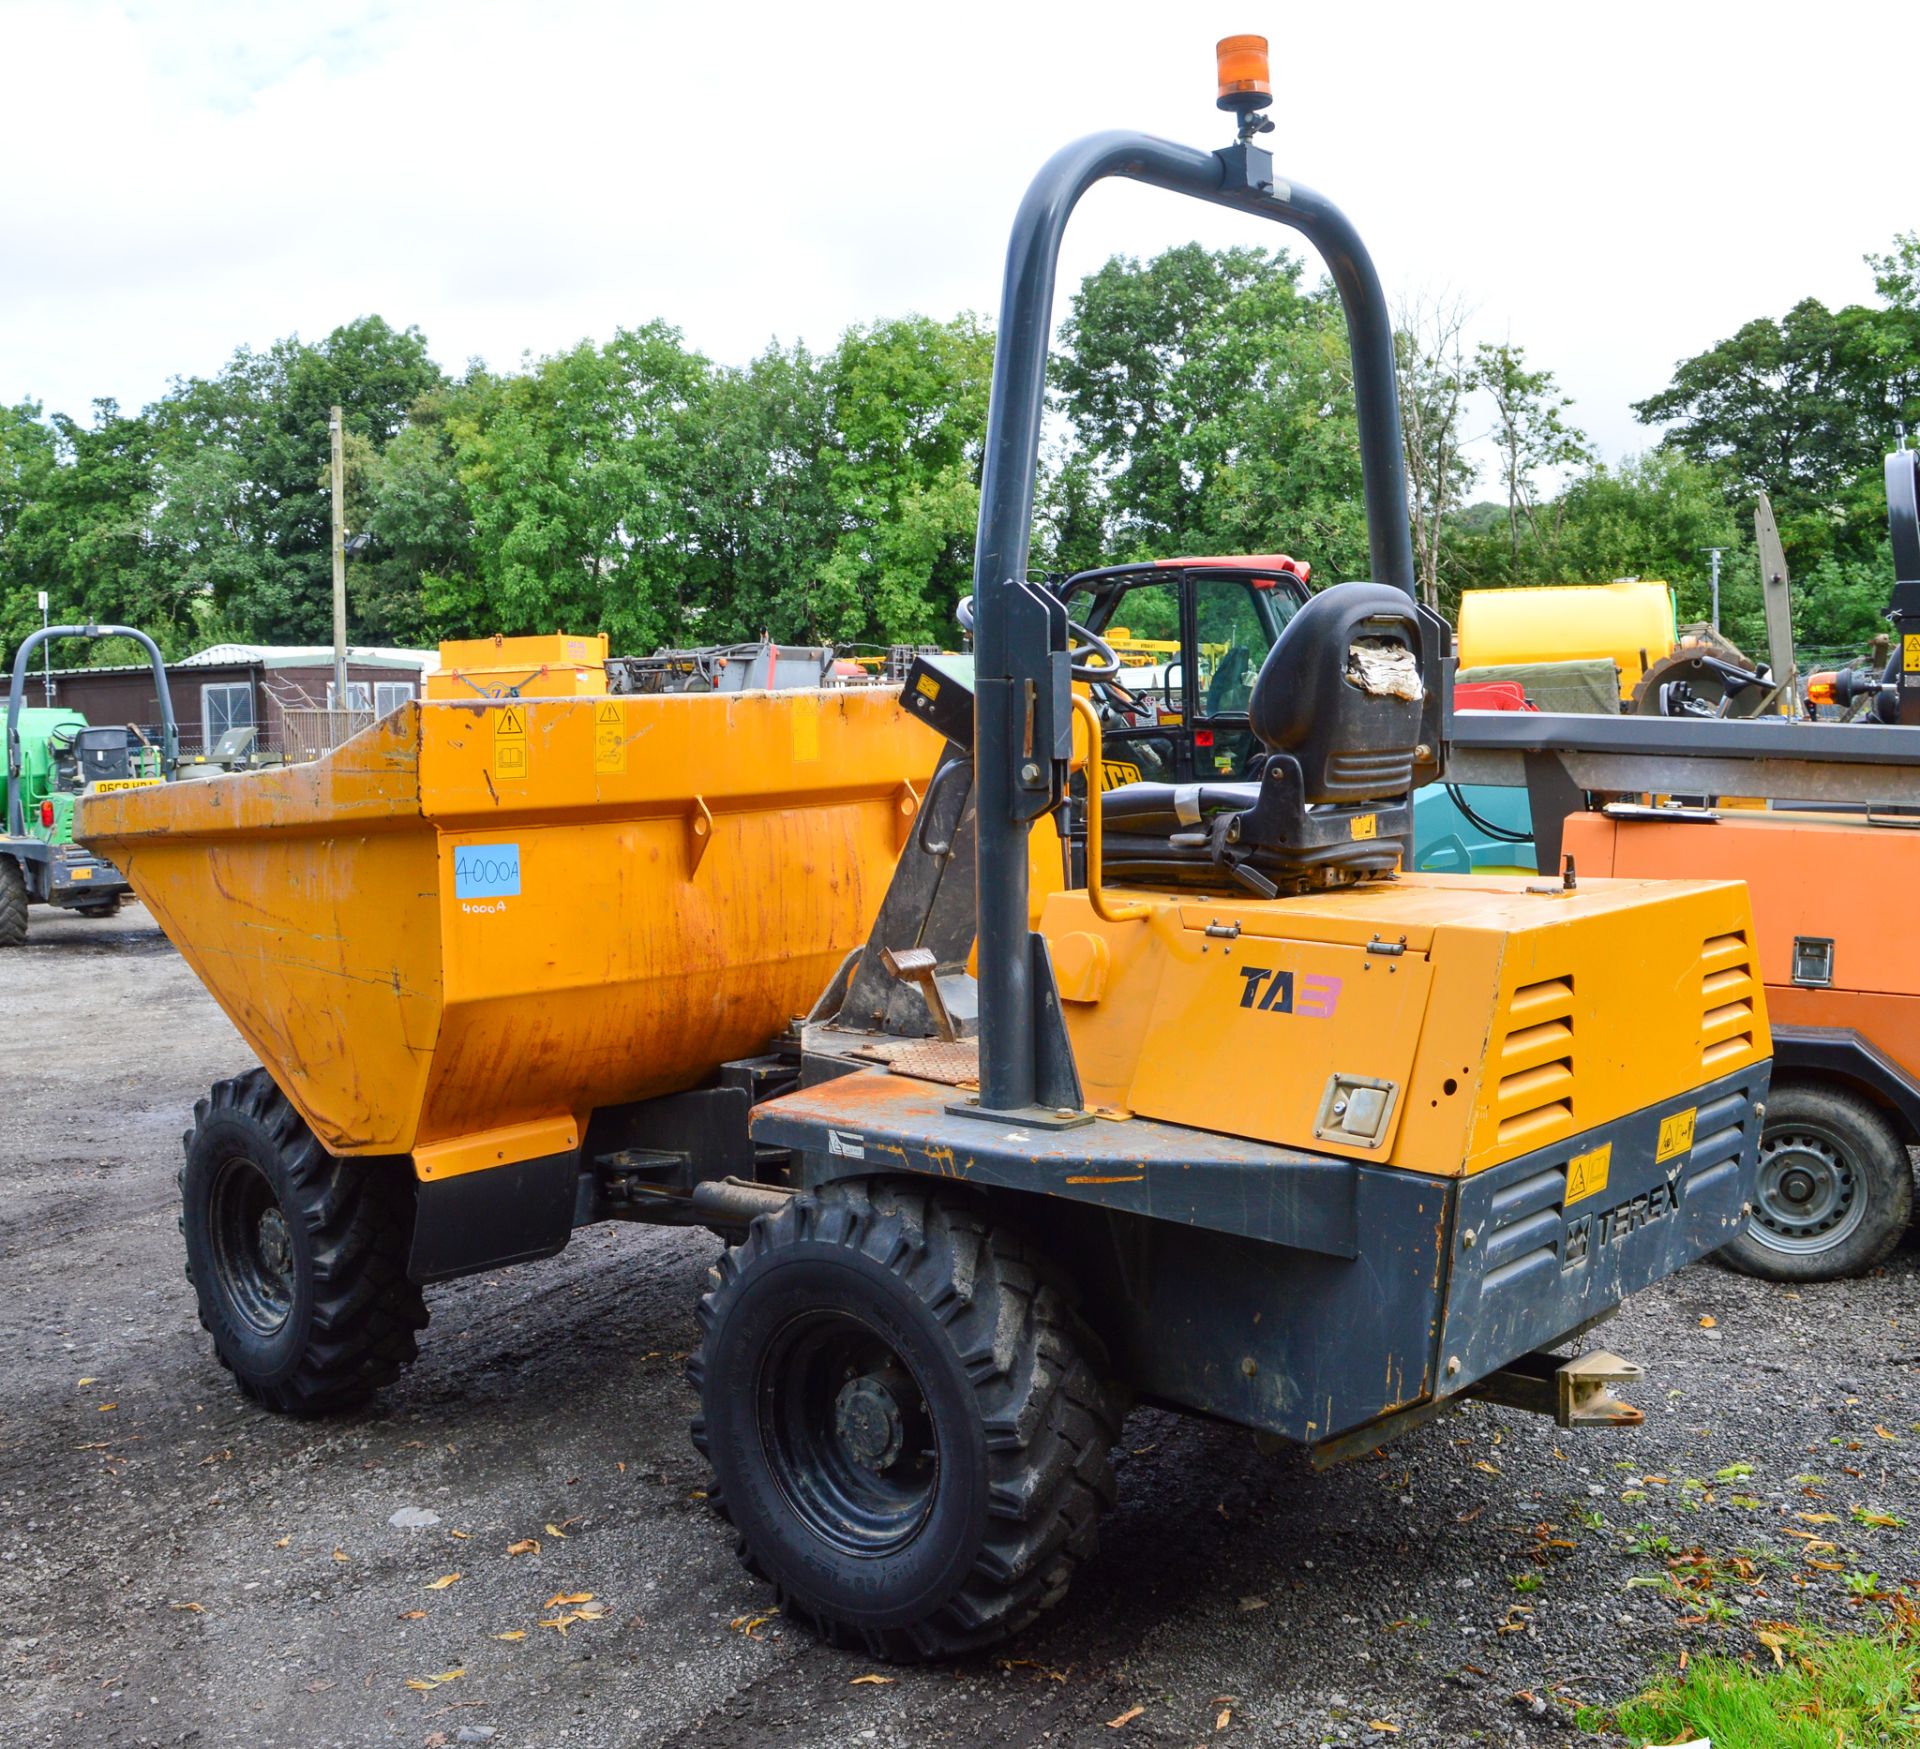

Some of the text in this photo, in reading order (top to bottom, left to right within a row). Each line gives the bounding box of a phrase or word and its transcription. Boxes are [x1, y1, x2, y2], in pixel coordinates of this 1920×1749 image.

[455, 857, 519, 886] 4000A
[462, 900, 507, 915] 4000A
[1240, 966, 1343, 1019] TA3
[1597, 1174, 1682, 1248] TEREX
